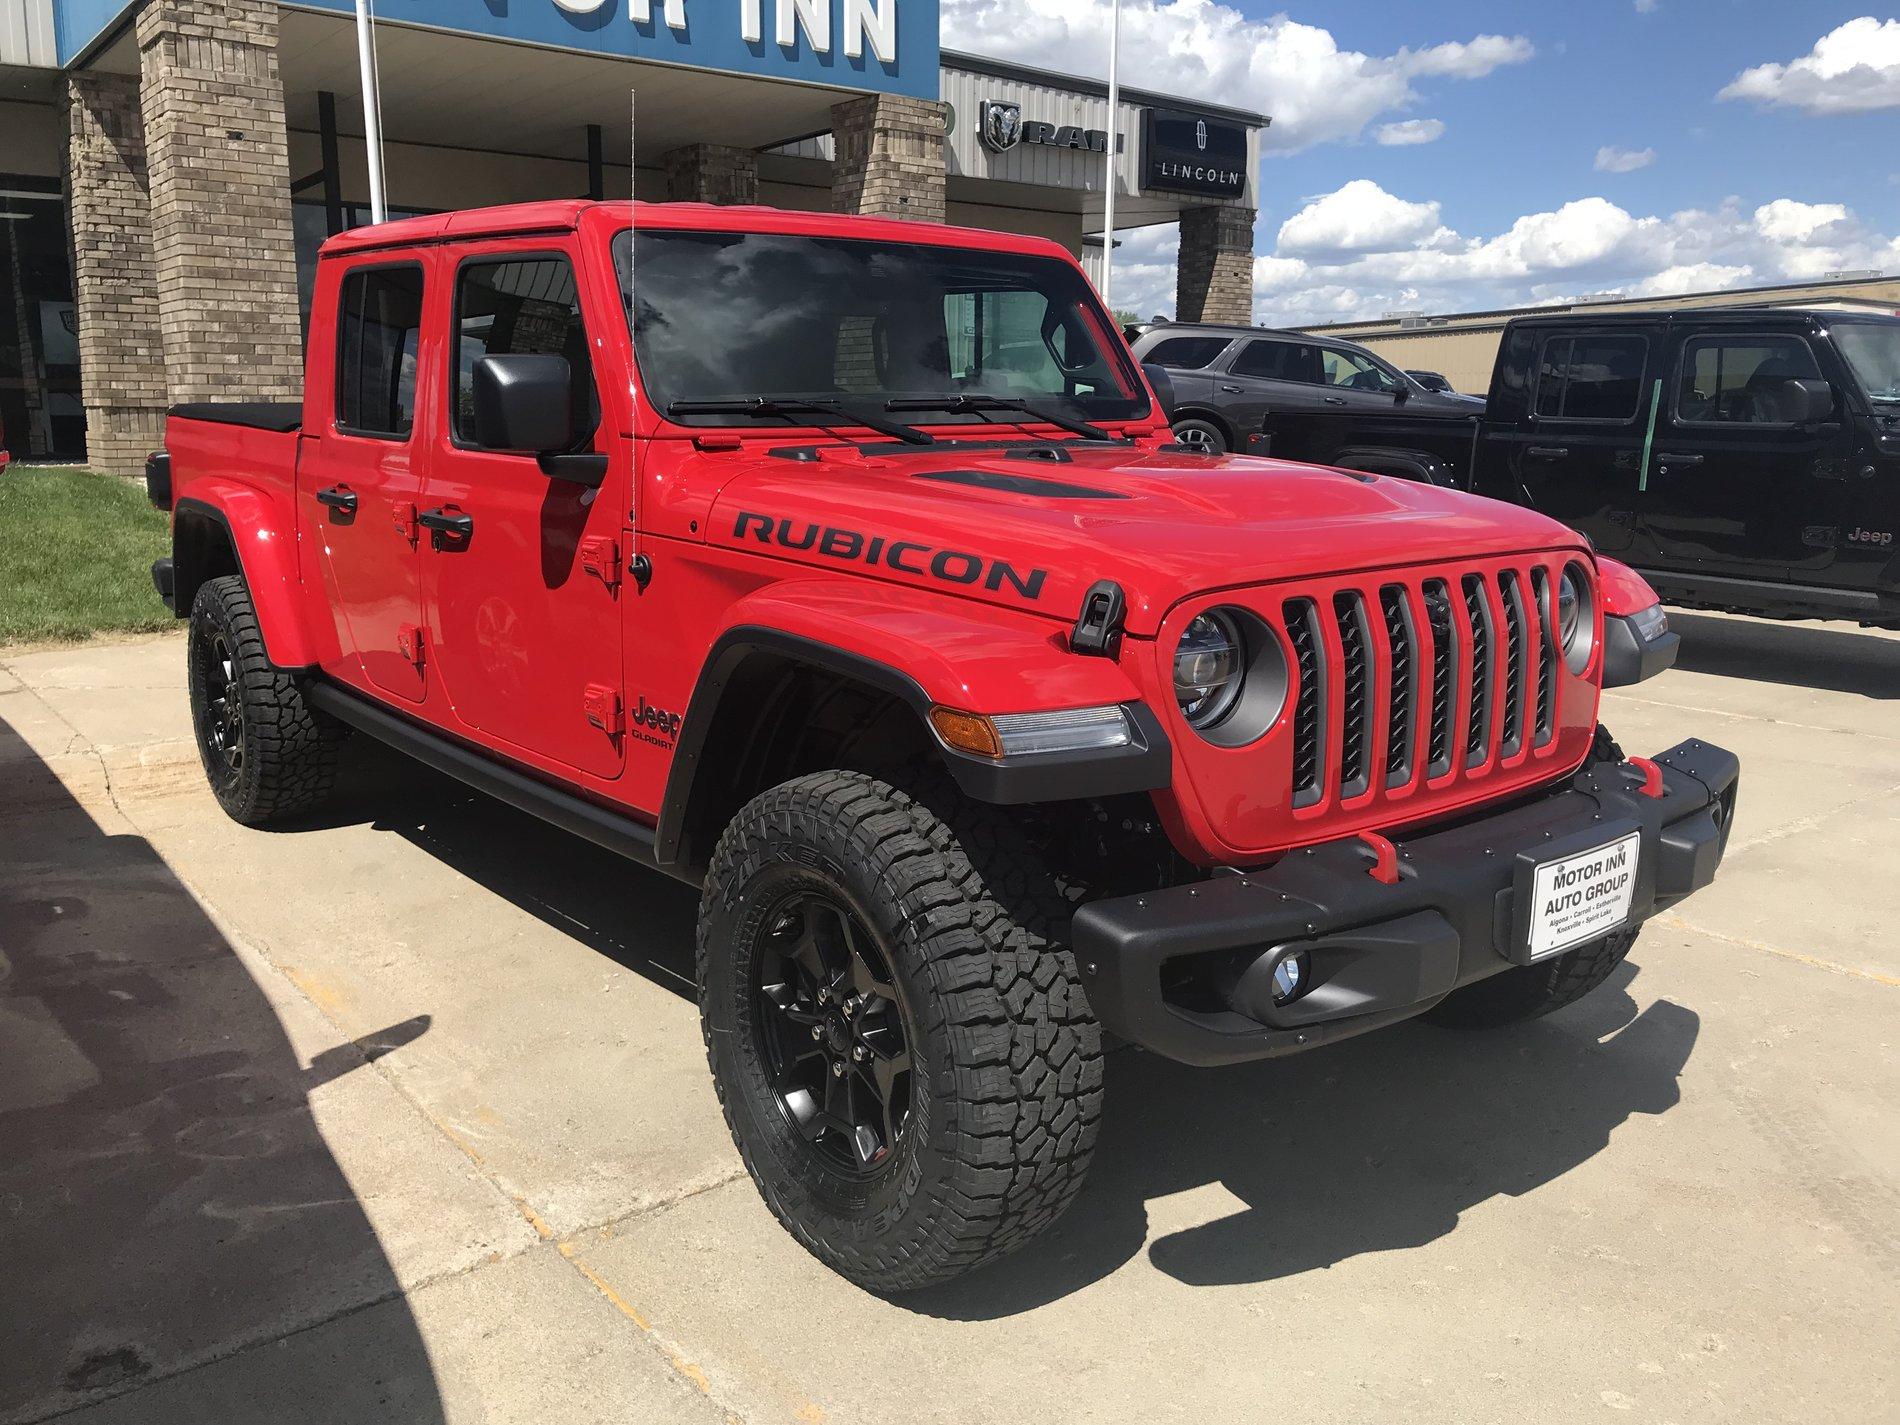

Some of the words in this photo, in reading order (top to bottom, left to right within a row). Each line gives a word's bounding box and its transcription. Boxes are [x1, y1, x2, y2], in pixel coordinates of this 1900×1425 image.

[1022, 121, 1124, 153] RAM
[1161, 162, 1239, 185] LINCOLN
[1848, 527, 1893, 545] Jeep
[733, 511, 1048, 600] RUBICON
[631, 695, 681, 741] Jeep
[631, 728, 674, 751] GLADIAT
[1553, 861, 1602, 890] MOTOR
[1605, 852, 1626, 872] INN
[1545, 891, 1582, 916] AUTO
[1586, 873, 1628, 901] GROUP
[1549, 916, 1569, 928] Algona
[1573, 906, 1592, 918] Carroll
[1596, 895, 1621, 909] Estherville
[1556, 921, 1582, 934] Knoxville
[1586, 913, 1600, 924] Spirit
[1600, 908, 1612, 917] Lake
